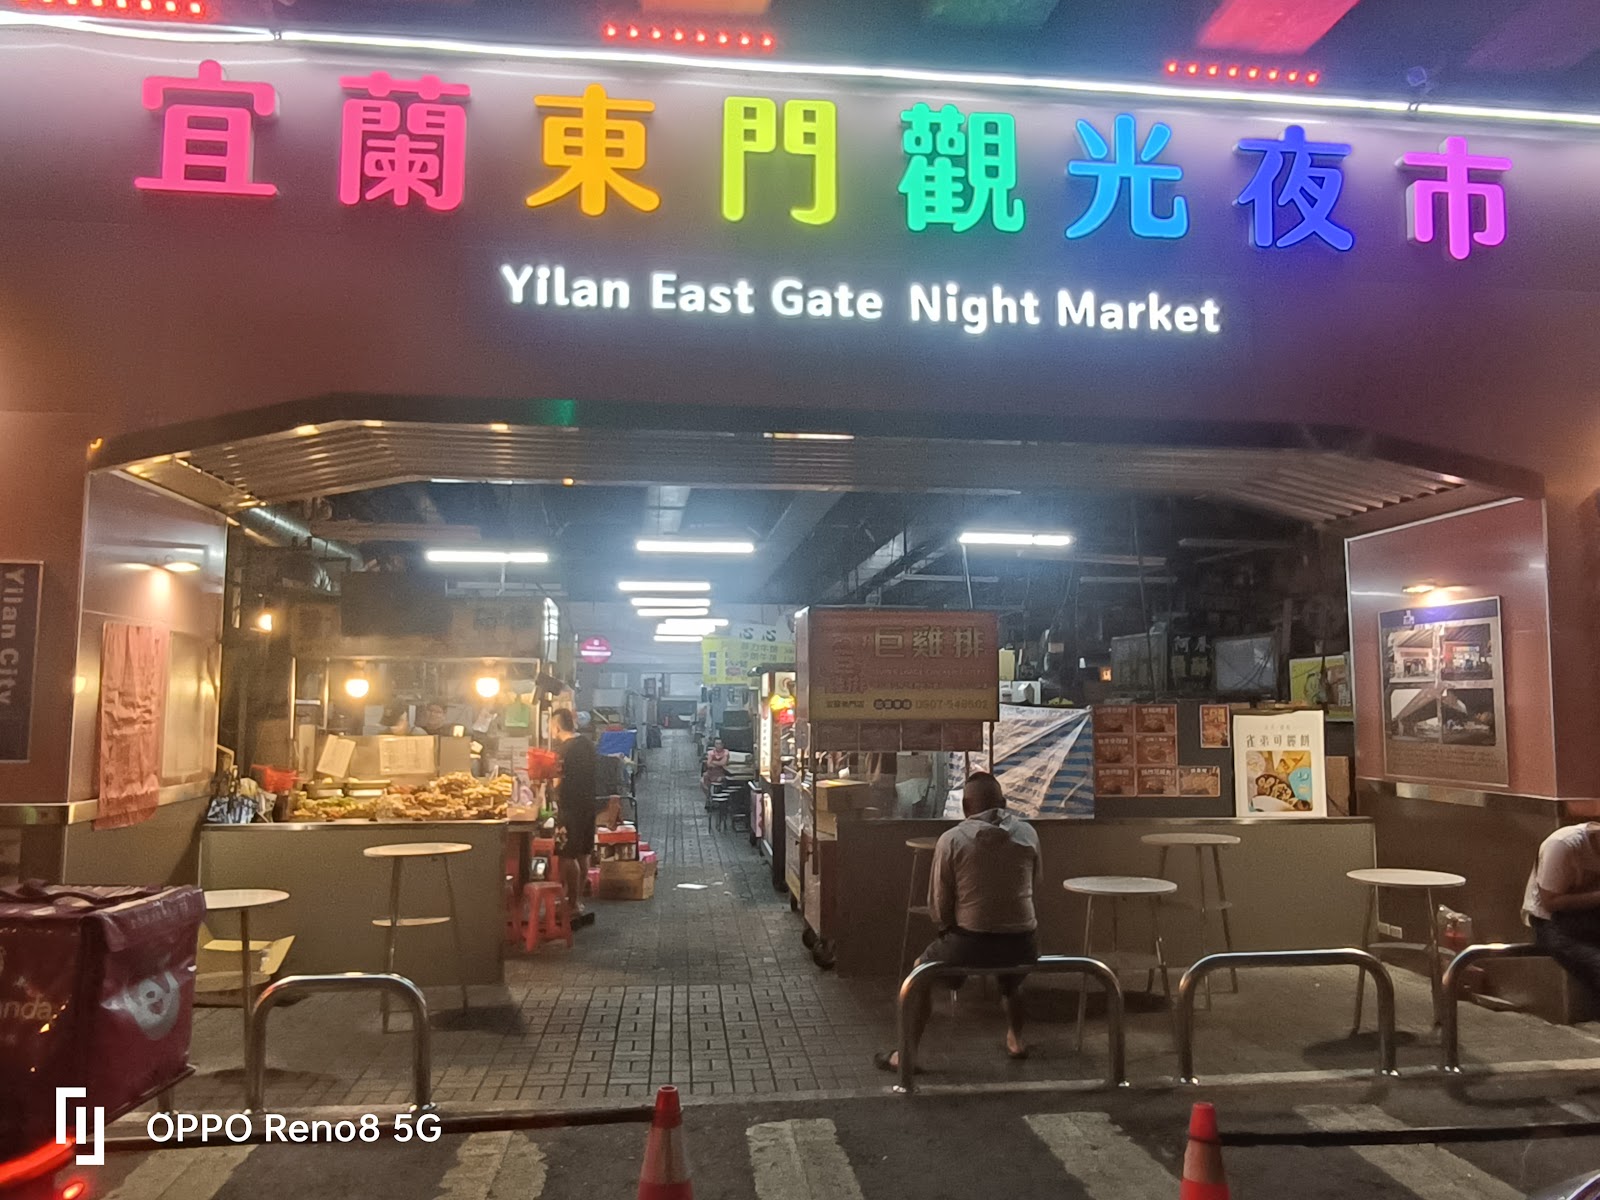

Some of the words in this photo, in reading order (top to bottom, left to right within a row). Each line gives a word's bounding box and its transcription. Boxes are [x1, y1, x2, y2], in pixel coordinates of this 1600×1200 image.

[133, 60, 1512, 259] 宜蘭東門觀光夜市
[501, 265, 630, 309] Yilan
[651, 272, 755, 314] East
[771, 278, 883, 319] Gate
[909, 282, 1040, 335] Night
[1057, 289, 1220, 333] Market
[1, 568, 25, 639] Yilan
[0, 648, 19, 705] City
